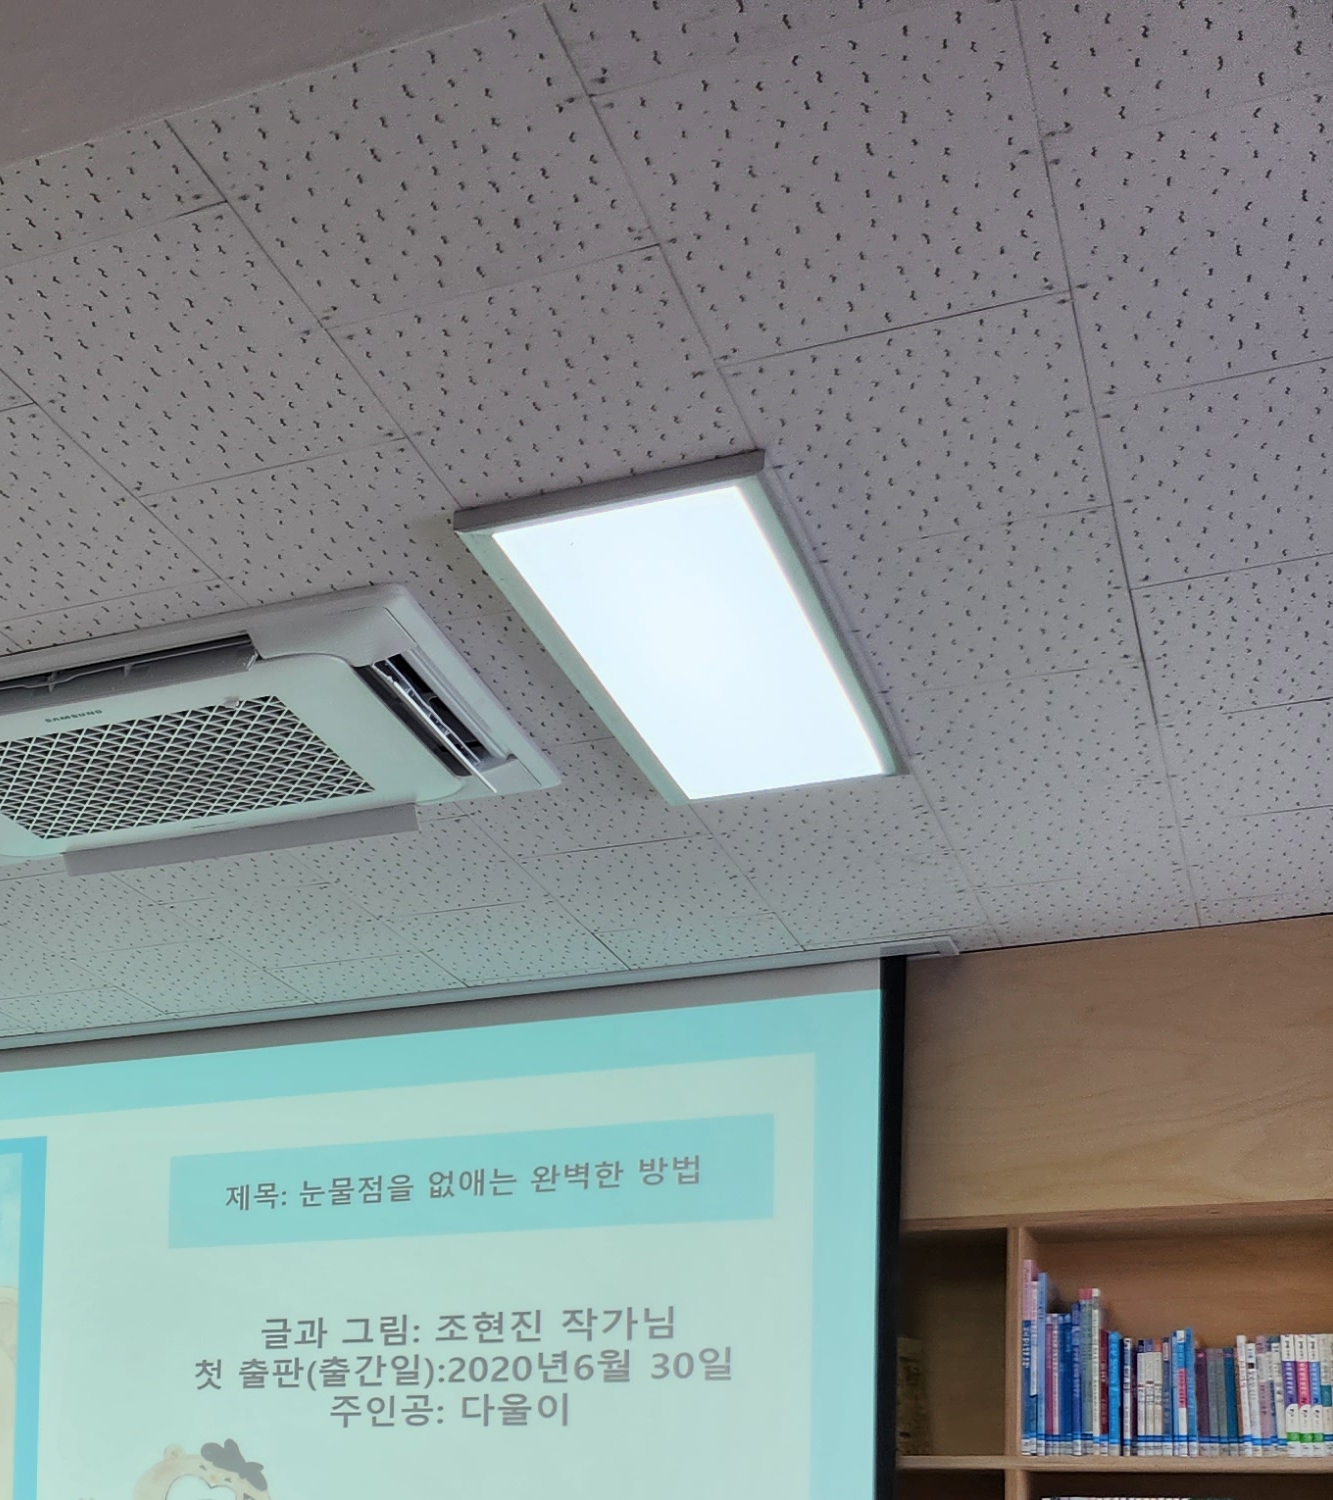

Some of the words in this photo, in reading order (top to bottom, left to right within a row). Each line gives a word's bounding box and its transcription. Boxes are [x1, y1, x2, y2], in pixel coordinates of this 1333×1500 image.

[44, 709, 103, 723] SAMSUNG
[225, 1182, 288, 1211] 제목:
[299, 1173, 414, 1208] 눈물점을
[428, 1168, 517, 1199] 없애는
[531, 1160, 624, 1193] 완벽한
[638, 1154, 700, 1187] 방법
[261, 1317, 328, 1350] 글과
[341, 1313, 420, 1347] 그림:
[435, 1309, 542, 1344] 조현진
[561, 1305, 674, 1342] 작가님
[195, 1358, 223, 1391] 첫
[238, 1348, 630, 1392] 출판(출간일):2020년6월
[650, 1346, 732, 1382] 30일
[330, 1394, 444, 1428] 주인공:
[461, 1392, 569, 1427] 다울이
